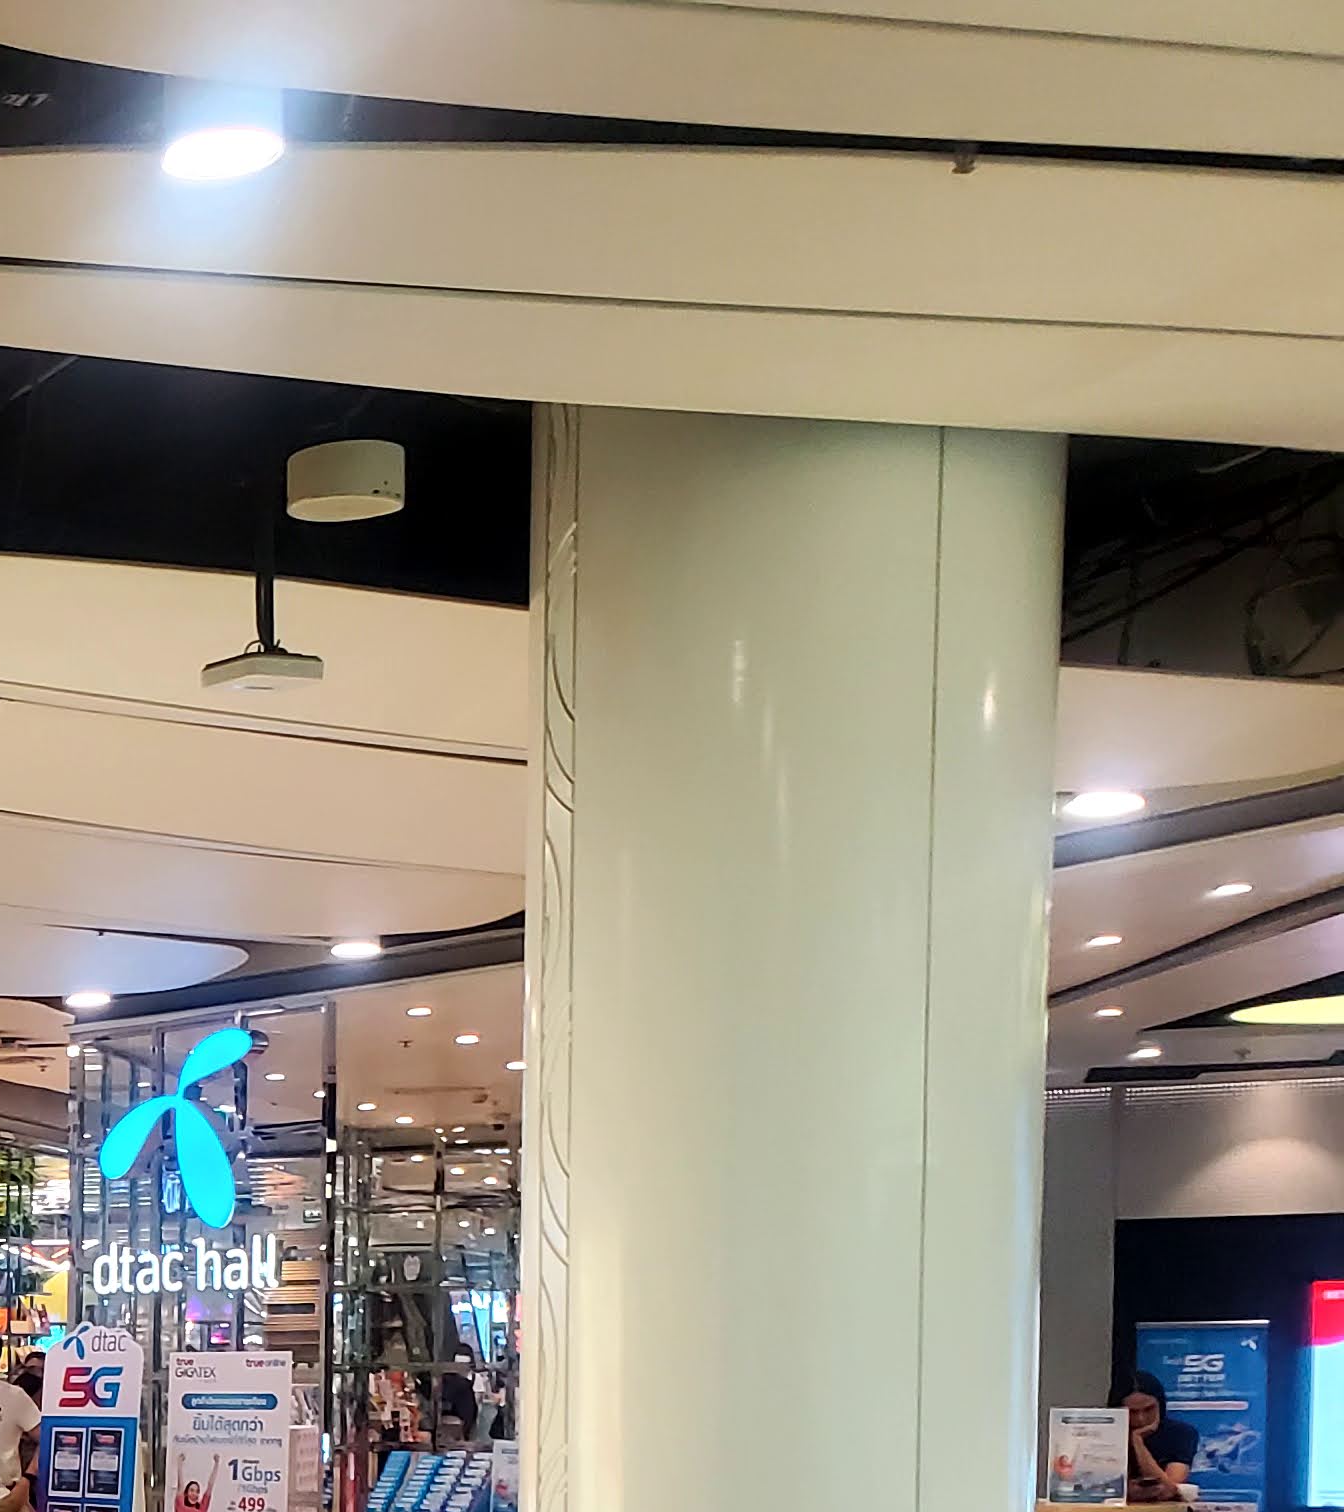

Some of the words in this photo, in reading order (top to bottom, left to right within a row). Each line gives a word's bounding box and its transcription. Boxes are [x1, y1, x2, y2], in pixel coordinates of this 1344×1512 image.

[90, 1241, 184, 1295] dtac
[191, 1233, 279, 1291] hall
[91, 1332, 127, 1353] dtac
[176, 1357, 194, 1366] true
[1182, 1353, 1225, 1373] 5G
[58, 1365, 124, 1409] 5G
[227, 1458, 239, 1481] 1
[241, 1465, 282, 1486] Gbps
[238, 1496, 266, 1512] 499
